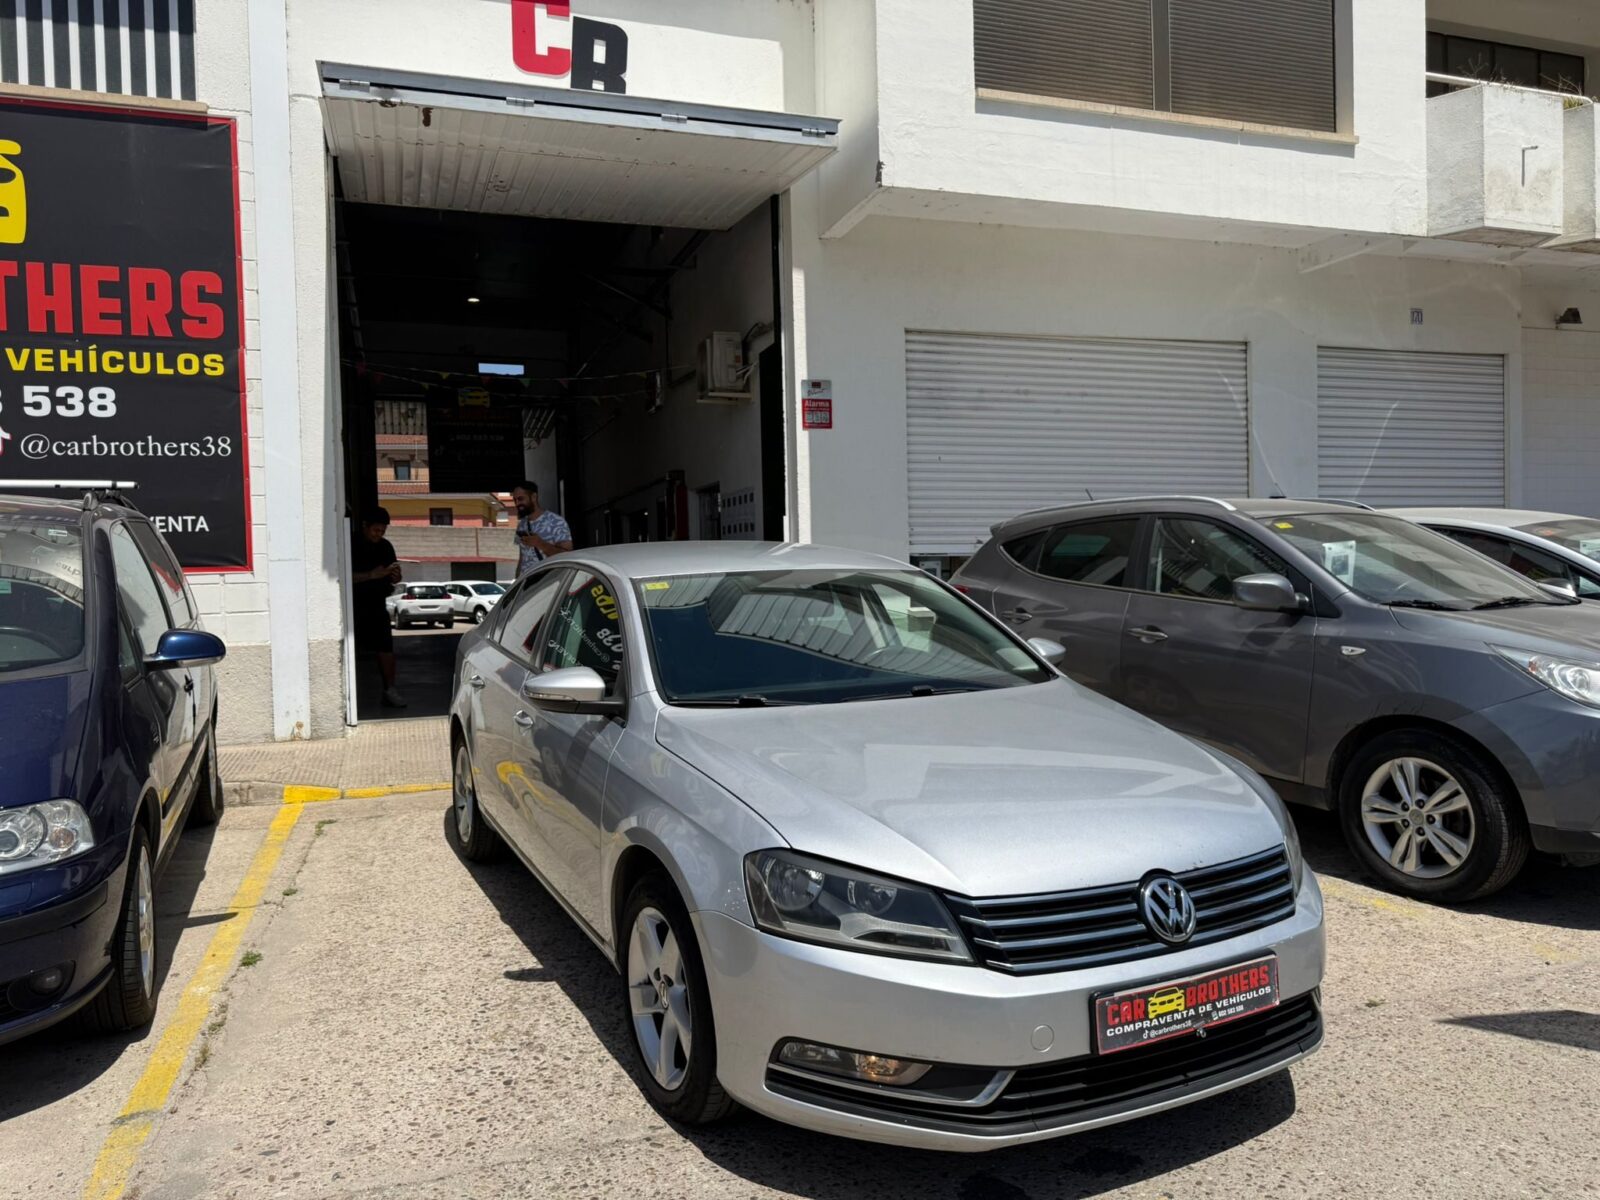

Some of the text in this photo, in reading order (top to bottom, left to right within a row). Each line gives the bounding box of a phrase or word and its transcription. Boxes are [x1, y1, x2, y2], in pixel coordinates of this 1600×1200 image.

[5, 344, 225, 376] VEHÍCULOS
[22, 385, 117, 418] 538
[20, 433, 232, 459] @carbrothers38
[149, 515, 210, 532] ENTA
[1106, 985, 1272, 1037] COMPRAVENTA DE VEHÍCULOS
[1107, 965, 1270, 1026] CAR BROTHERS
